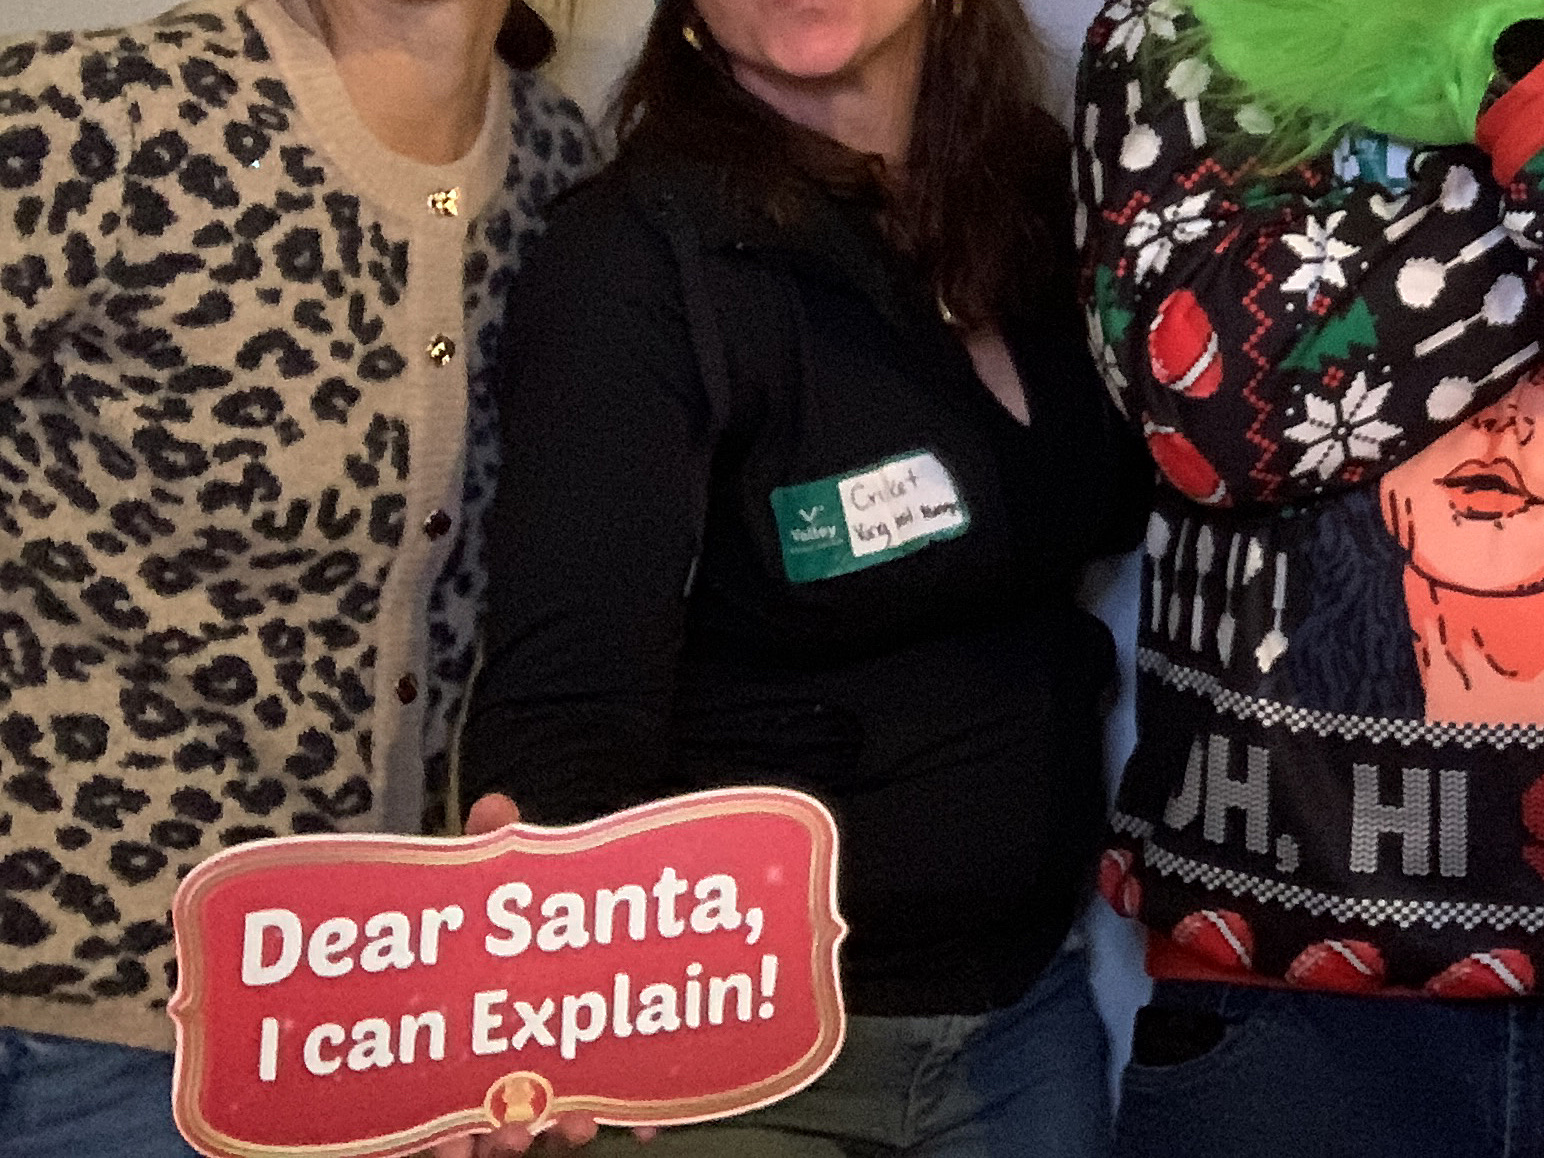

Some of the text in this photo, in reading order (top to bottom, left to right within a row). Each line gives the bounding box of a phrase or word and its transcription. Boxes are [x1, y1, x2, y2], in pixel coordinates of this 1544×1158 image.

[1349, 762, 1469, 878] HI
[241, 866, 764, 987] Dear Santa,
[259, 954, 779, 1082] I can Explain!
